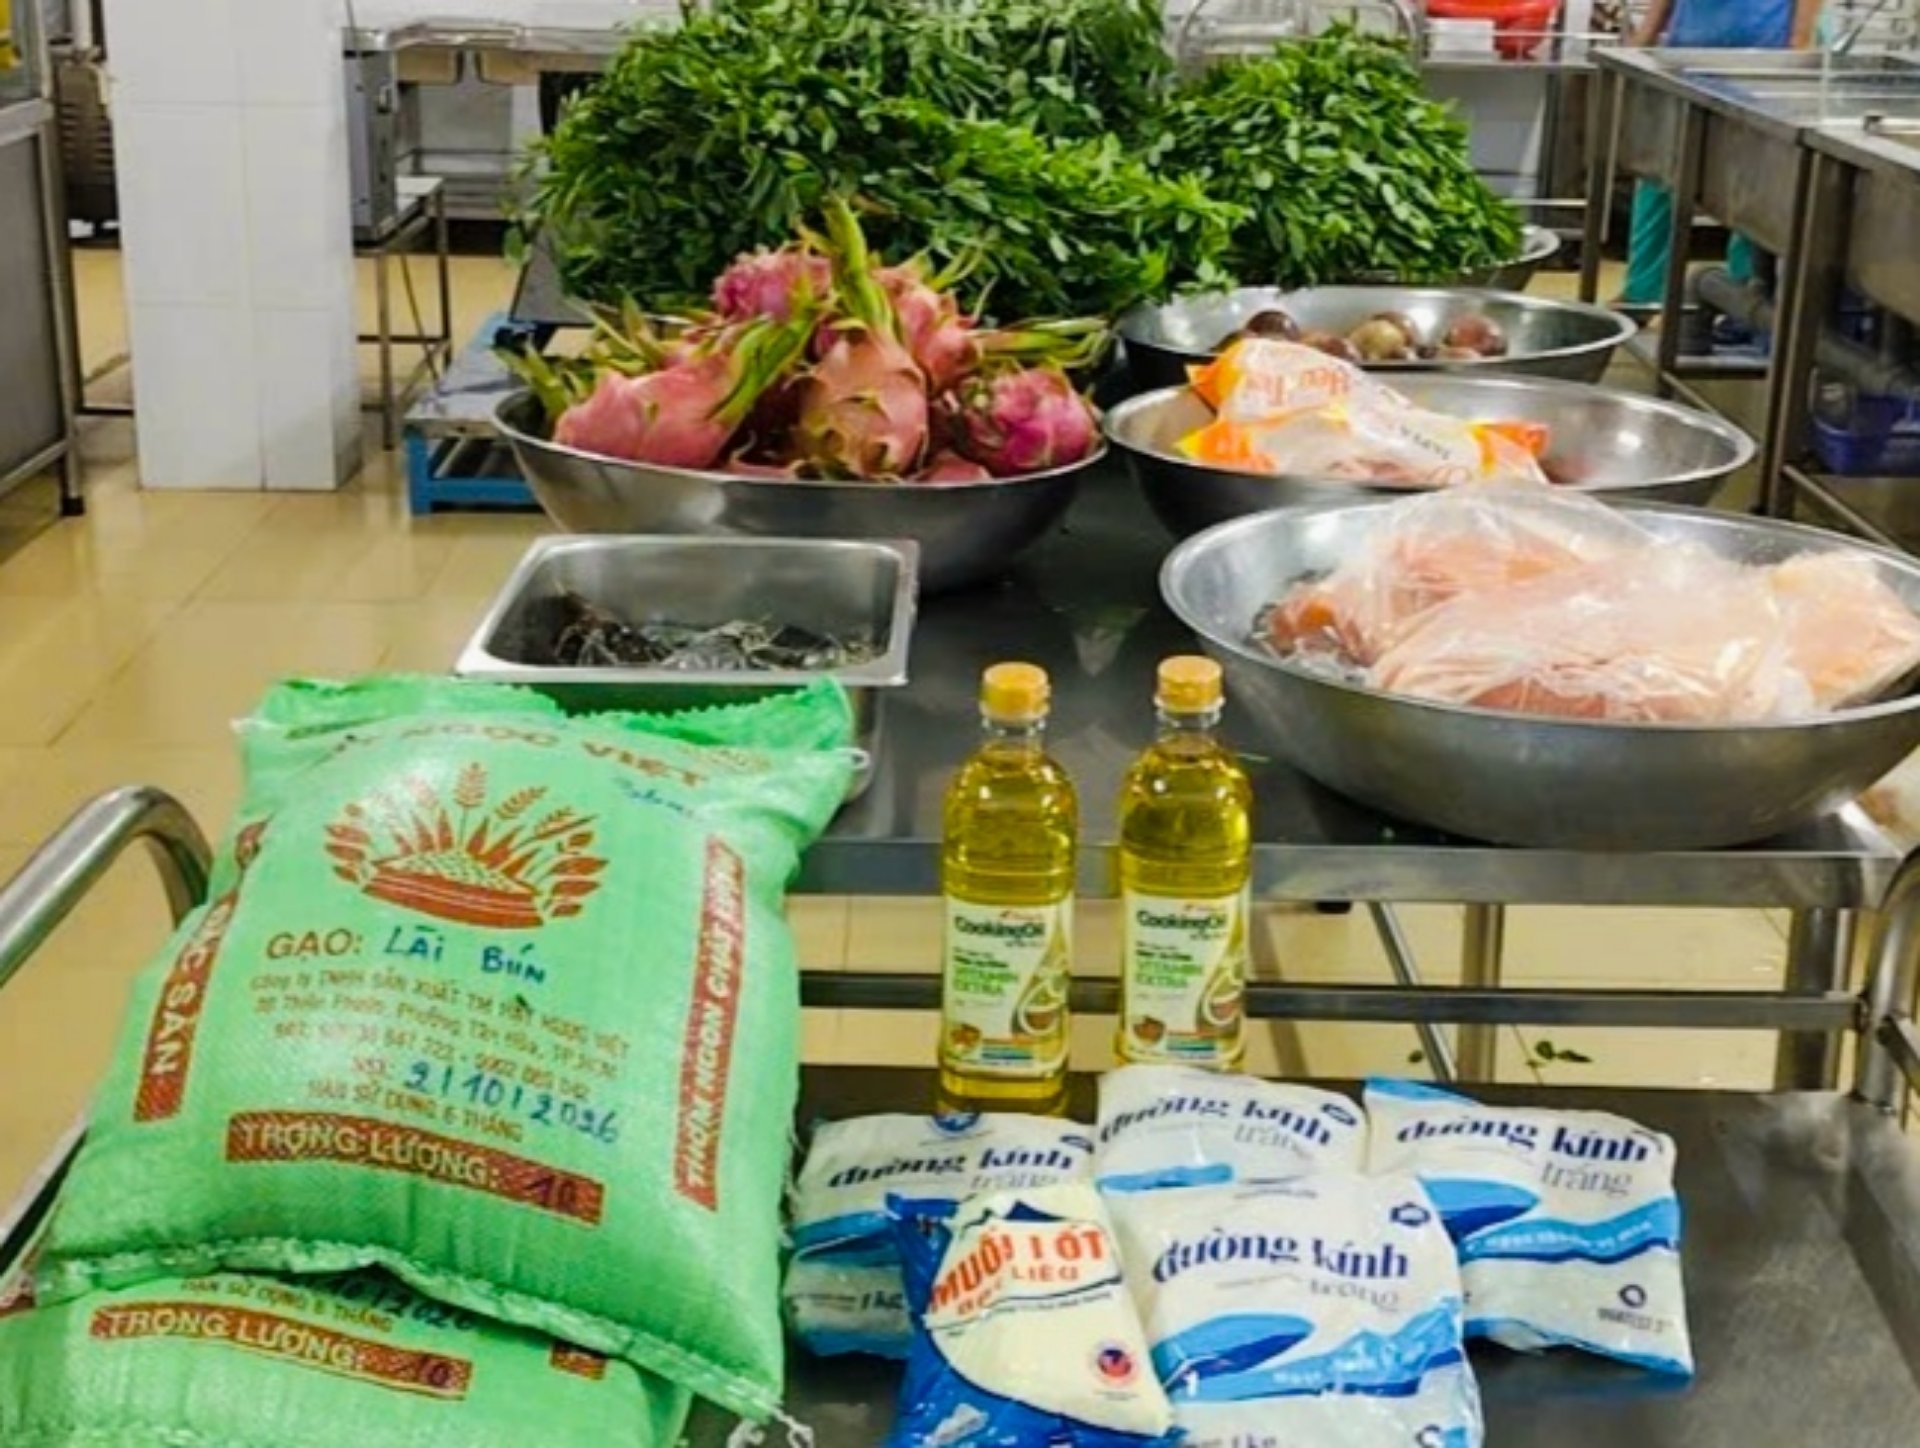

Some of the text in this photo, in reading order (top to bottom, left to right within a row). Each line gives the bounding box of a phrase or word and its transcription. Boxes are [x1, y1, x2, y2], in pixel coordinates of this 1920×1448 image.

[266, 928, 363, 961] GẠO:
[1312, 1238, 1408, 1279] kính
[108, 1307, 230, 1337] TRỌNG
